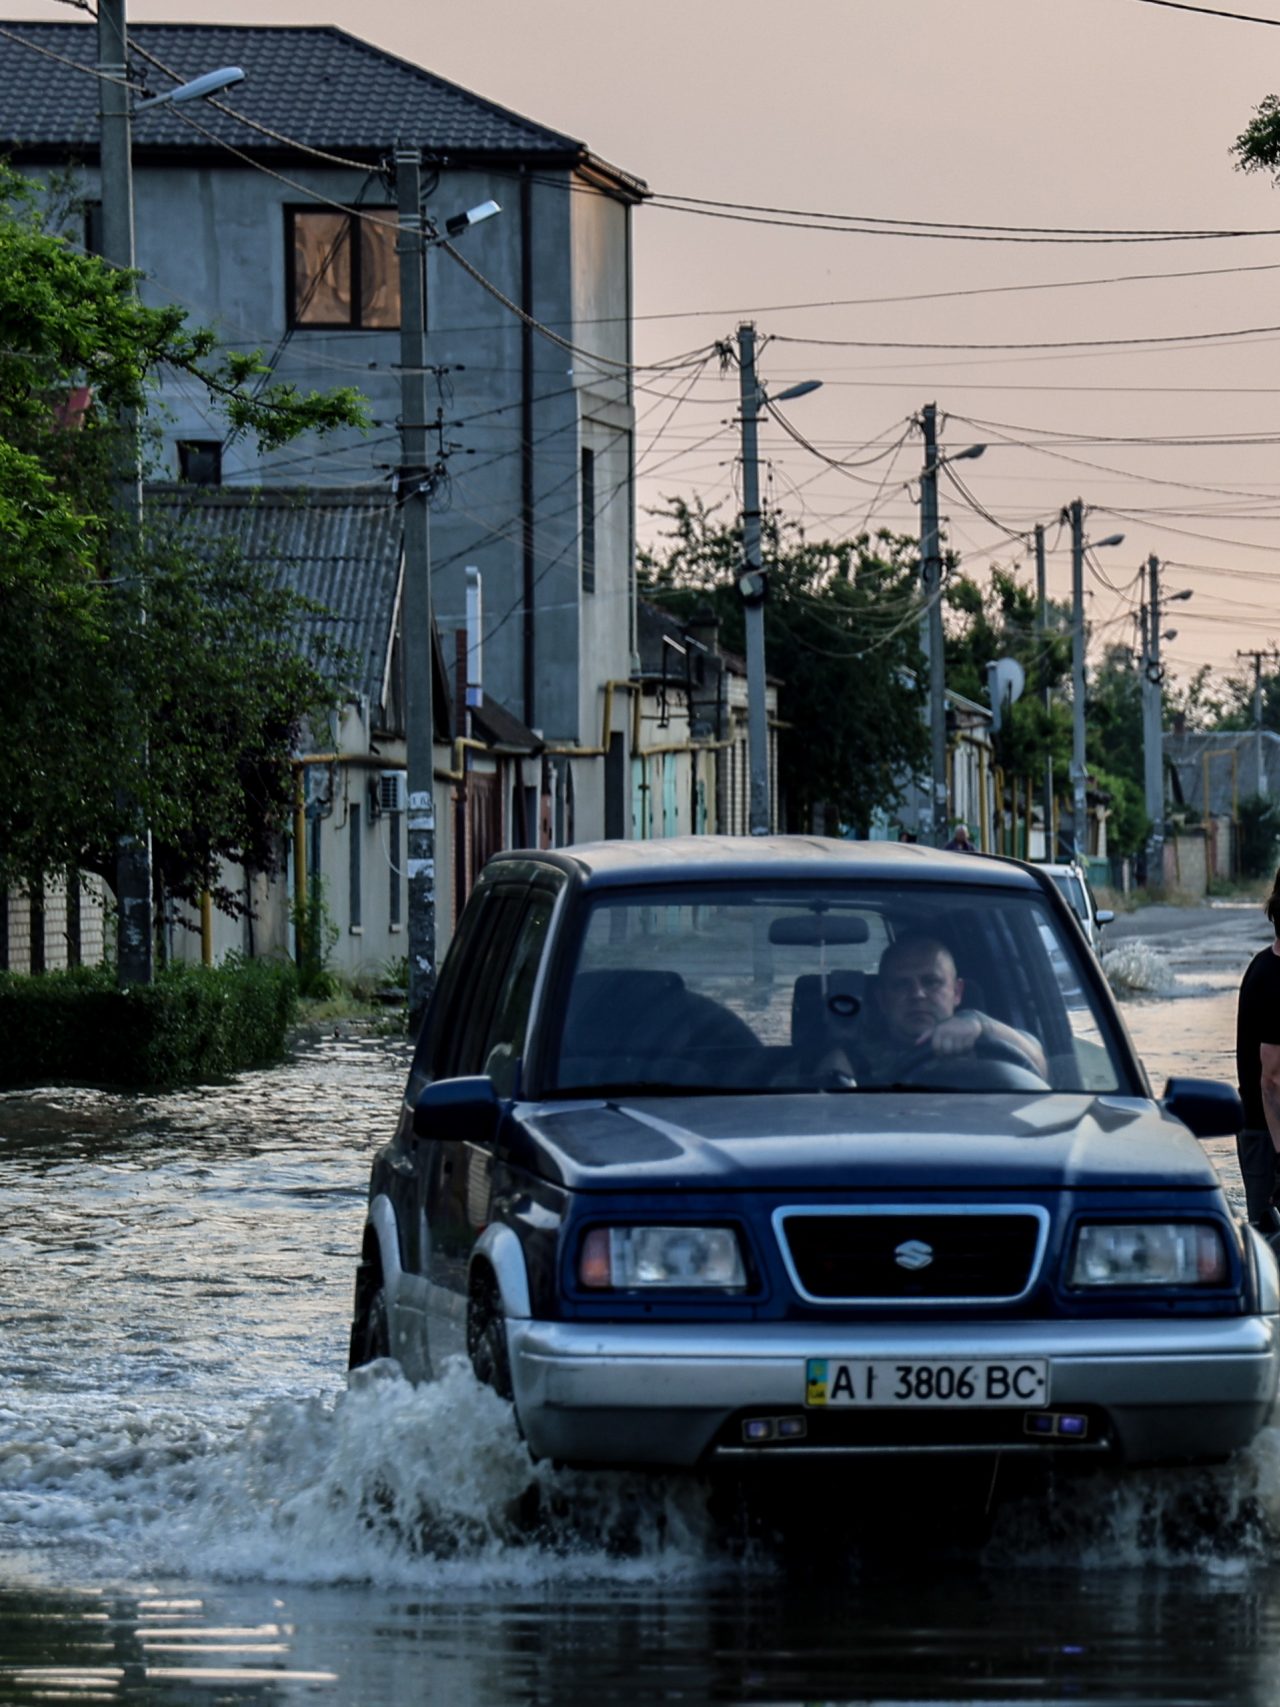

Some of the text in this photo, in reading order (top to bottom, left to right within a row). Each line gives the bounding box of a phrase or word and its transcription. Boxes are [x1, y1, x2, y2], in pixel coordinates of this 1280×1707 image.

[830, 1365, 1036, 1399] AI 3806 BC
